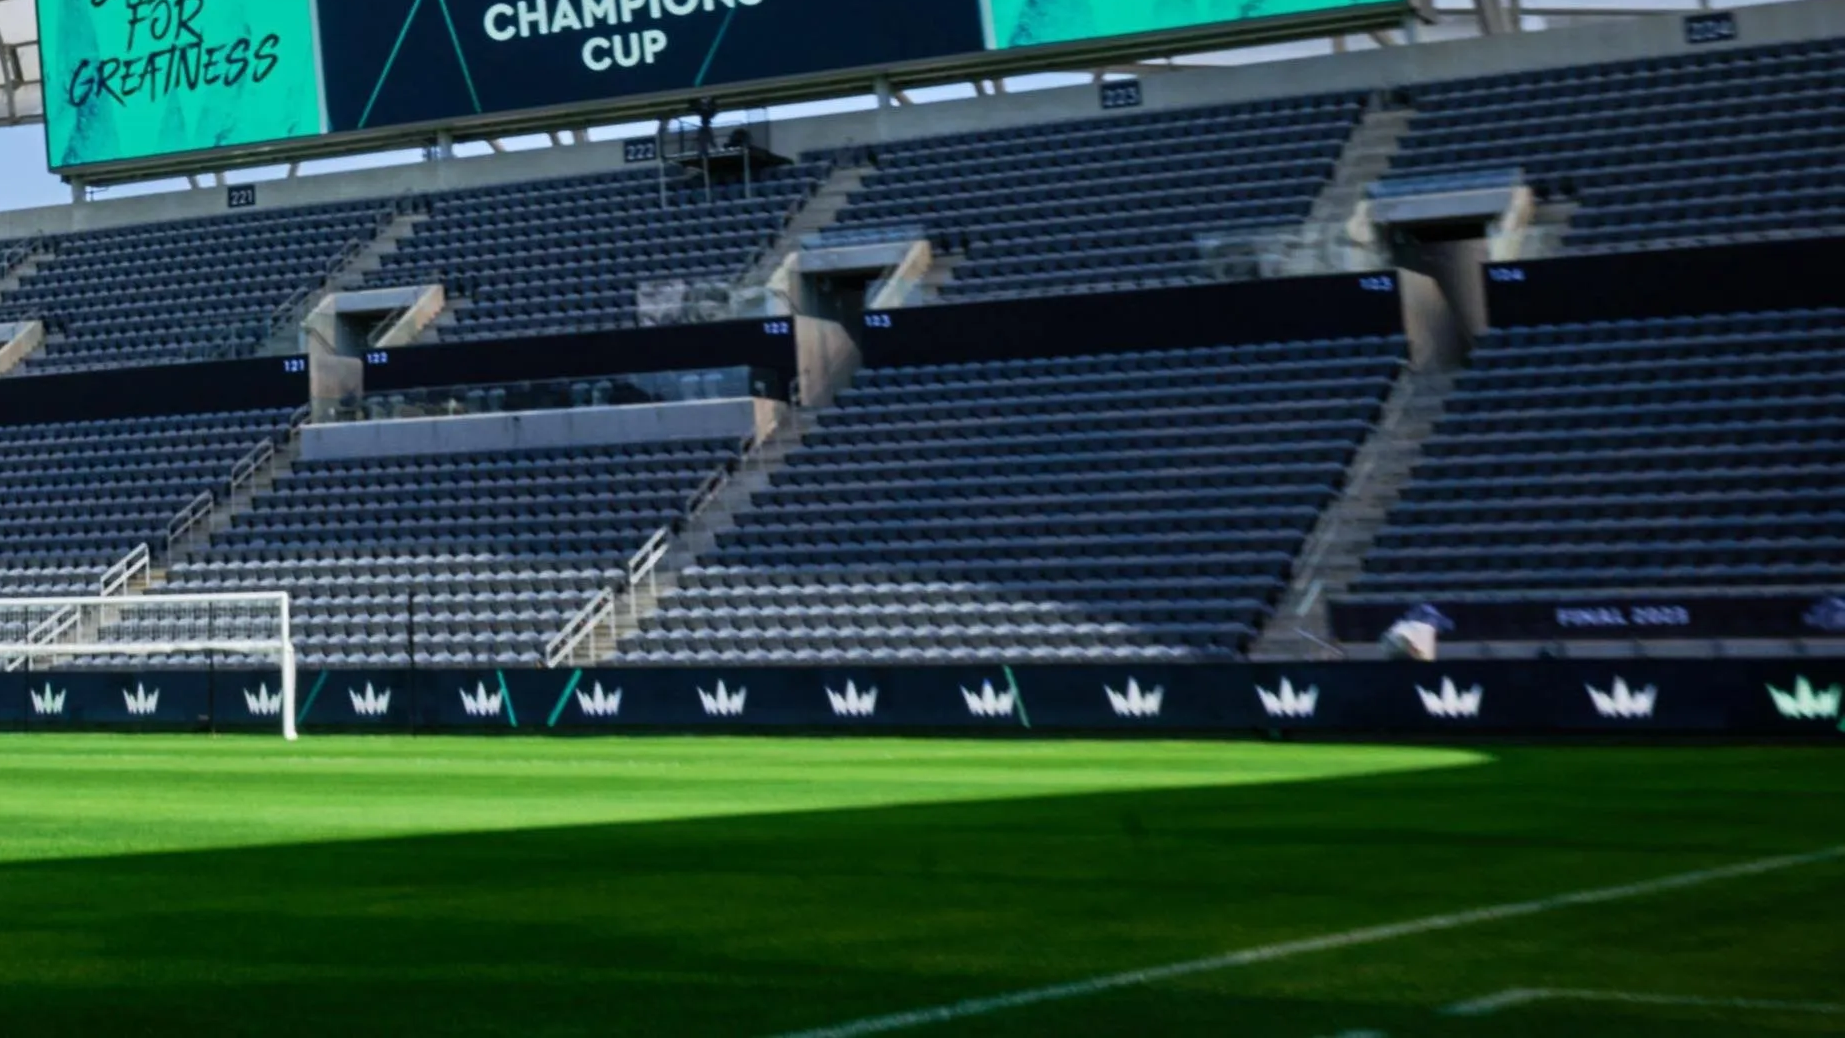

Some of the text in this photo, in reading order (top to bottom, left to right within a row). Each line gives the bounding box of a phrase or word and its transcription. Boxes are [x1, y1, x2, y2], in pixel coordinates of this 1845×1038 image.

[581, 31, 668, 71] CUP
[66, 33, 281, 108] GREATNESS
[626, 143, 654, 160] 222
[230, 189, 253, 205] 221
[763, 322, 789, 334] 122
[366, 351, 388, 363] 122
[283, 360, 305, 372] 121
[1556, 605, 1626, 626] FINAL
